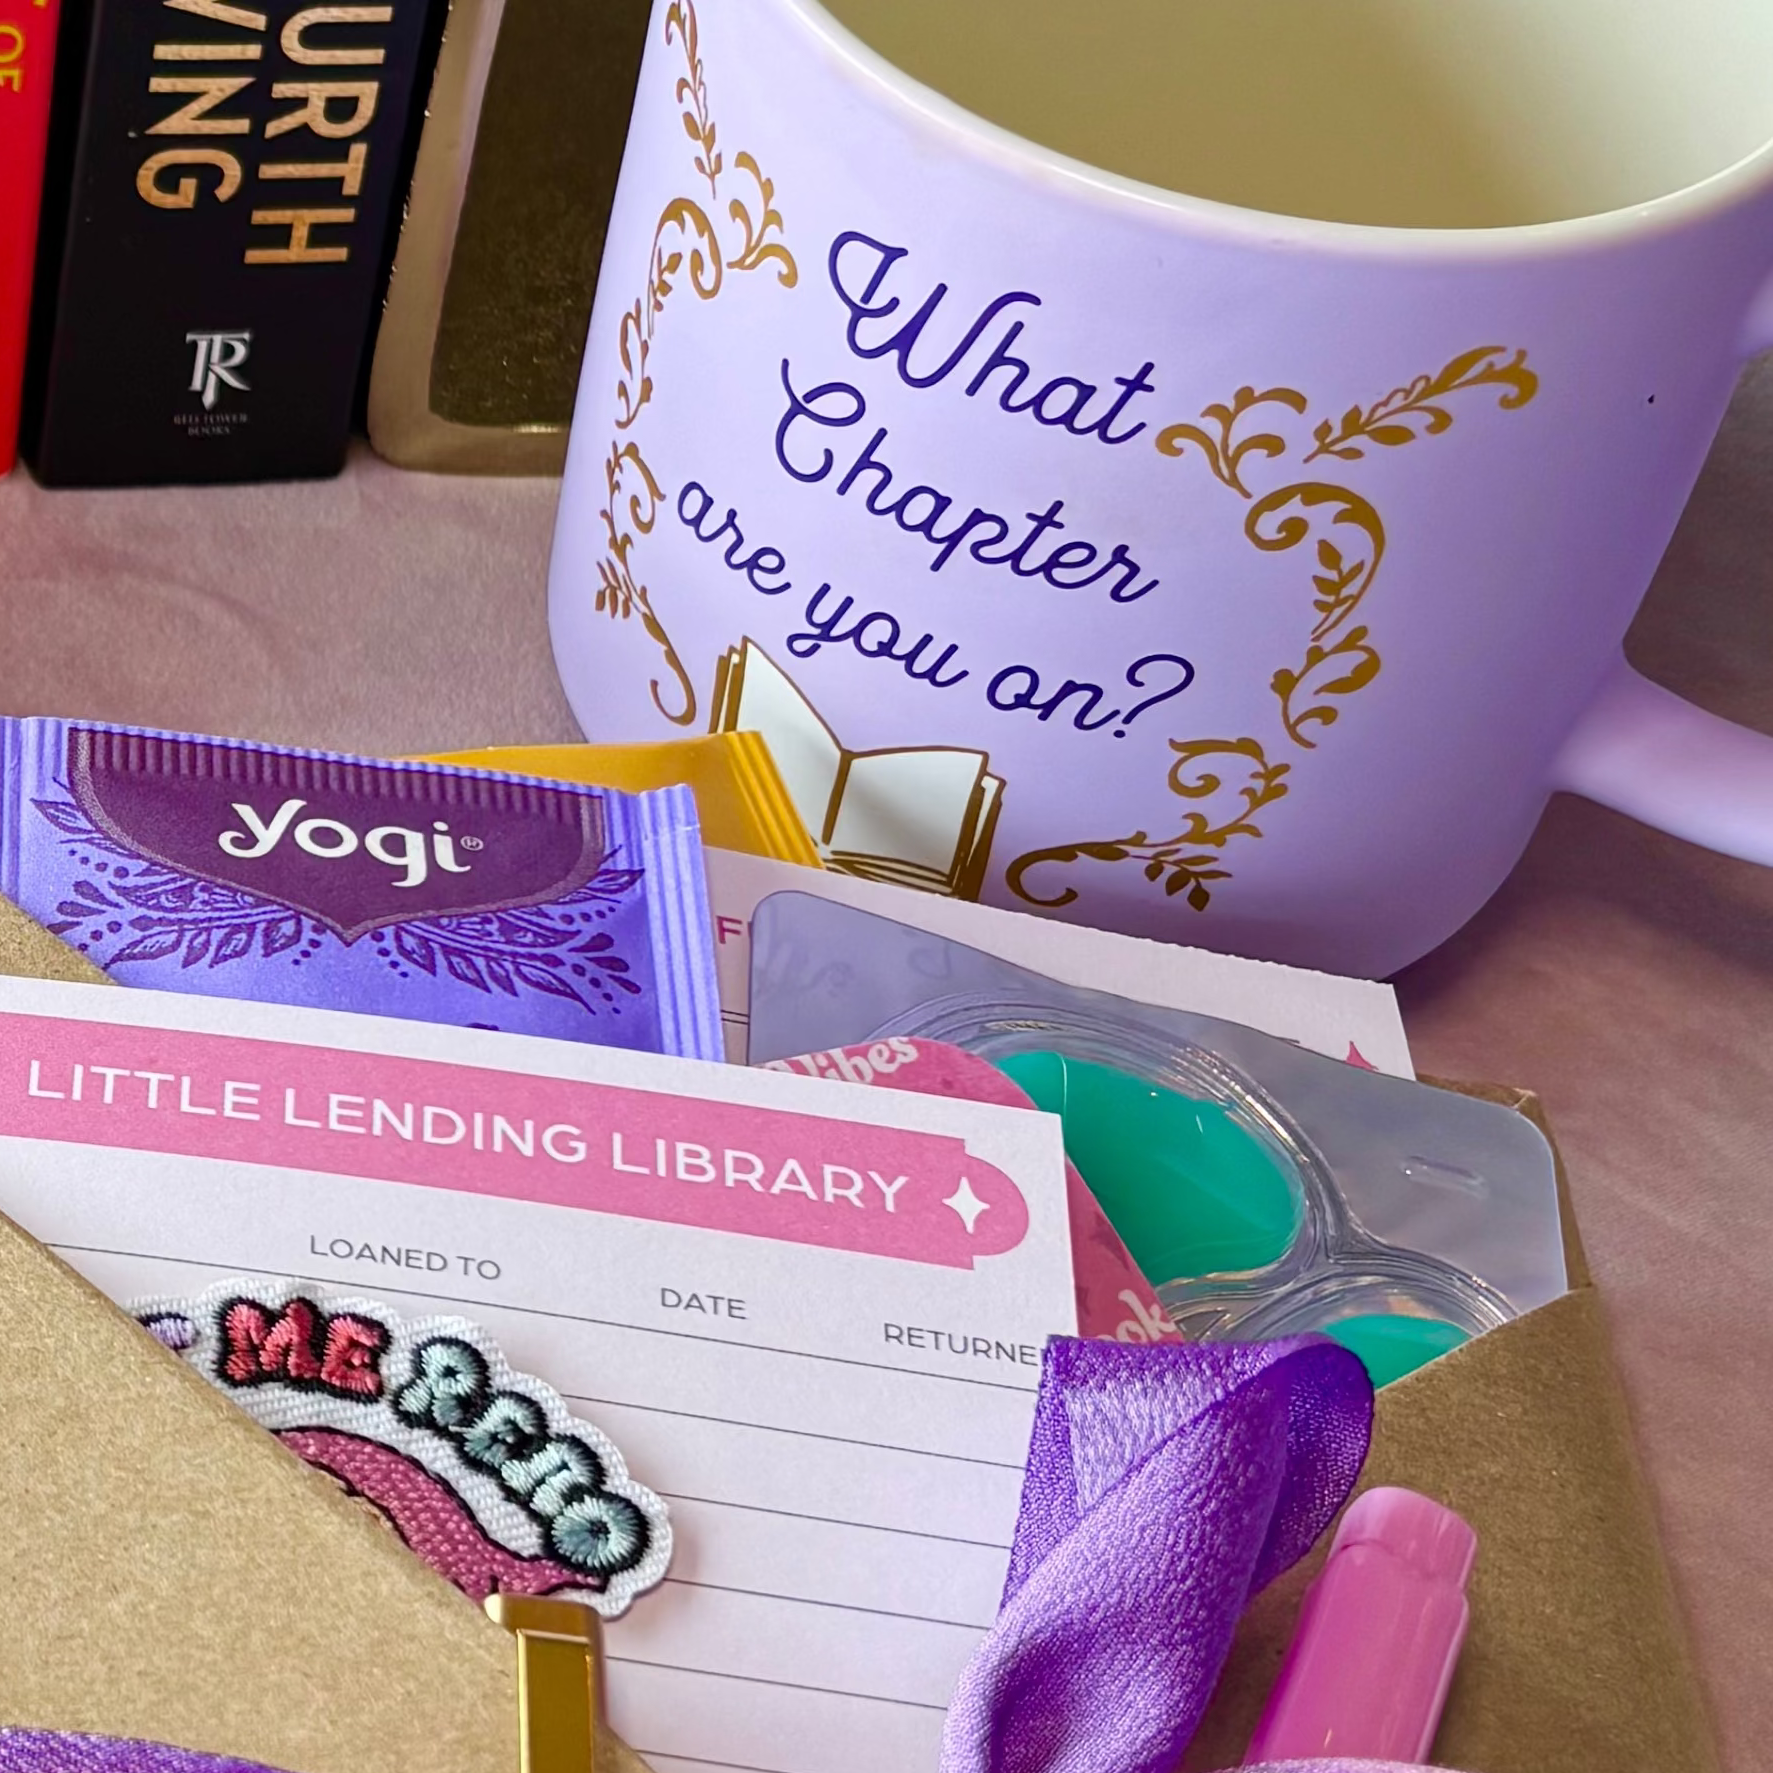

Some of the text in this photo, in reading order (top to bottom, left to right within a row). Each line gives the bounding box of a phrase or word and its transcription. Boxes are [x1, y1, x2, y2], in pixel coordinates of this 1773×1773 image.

[135, 0, 269, 210] ING
[243, 5, 394, 265] URTH
[829, 231, 1155, 446] What
[775, 358, 1160, 603] Chapter
[677, 481, 1196, 740] are you on?
[28, 1059, 910, 1216] LITTLE LENDING LIBRARY
[217, 1296, 392, 1402] ME
[309, 1234, 448, 1274] LOANED
[456, 1255, 501, 1281] TO
[660, 1287, 747, 1320] DATE
